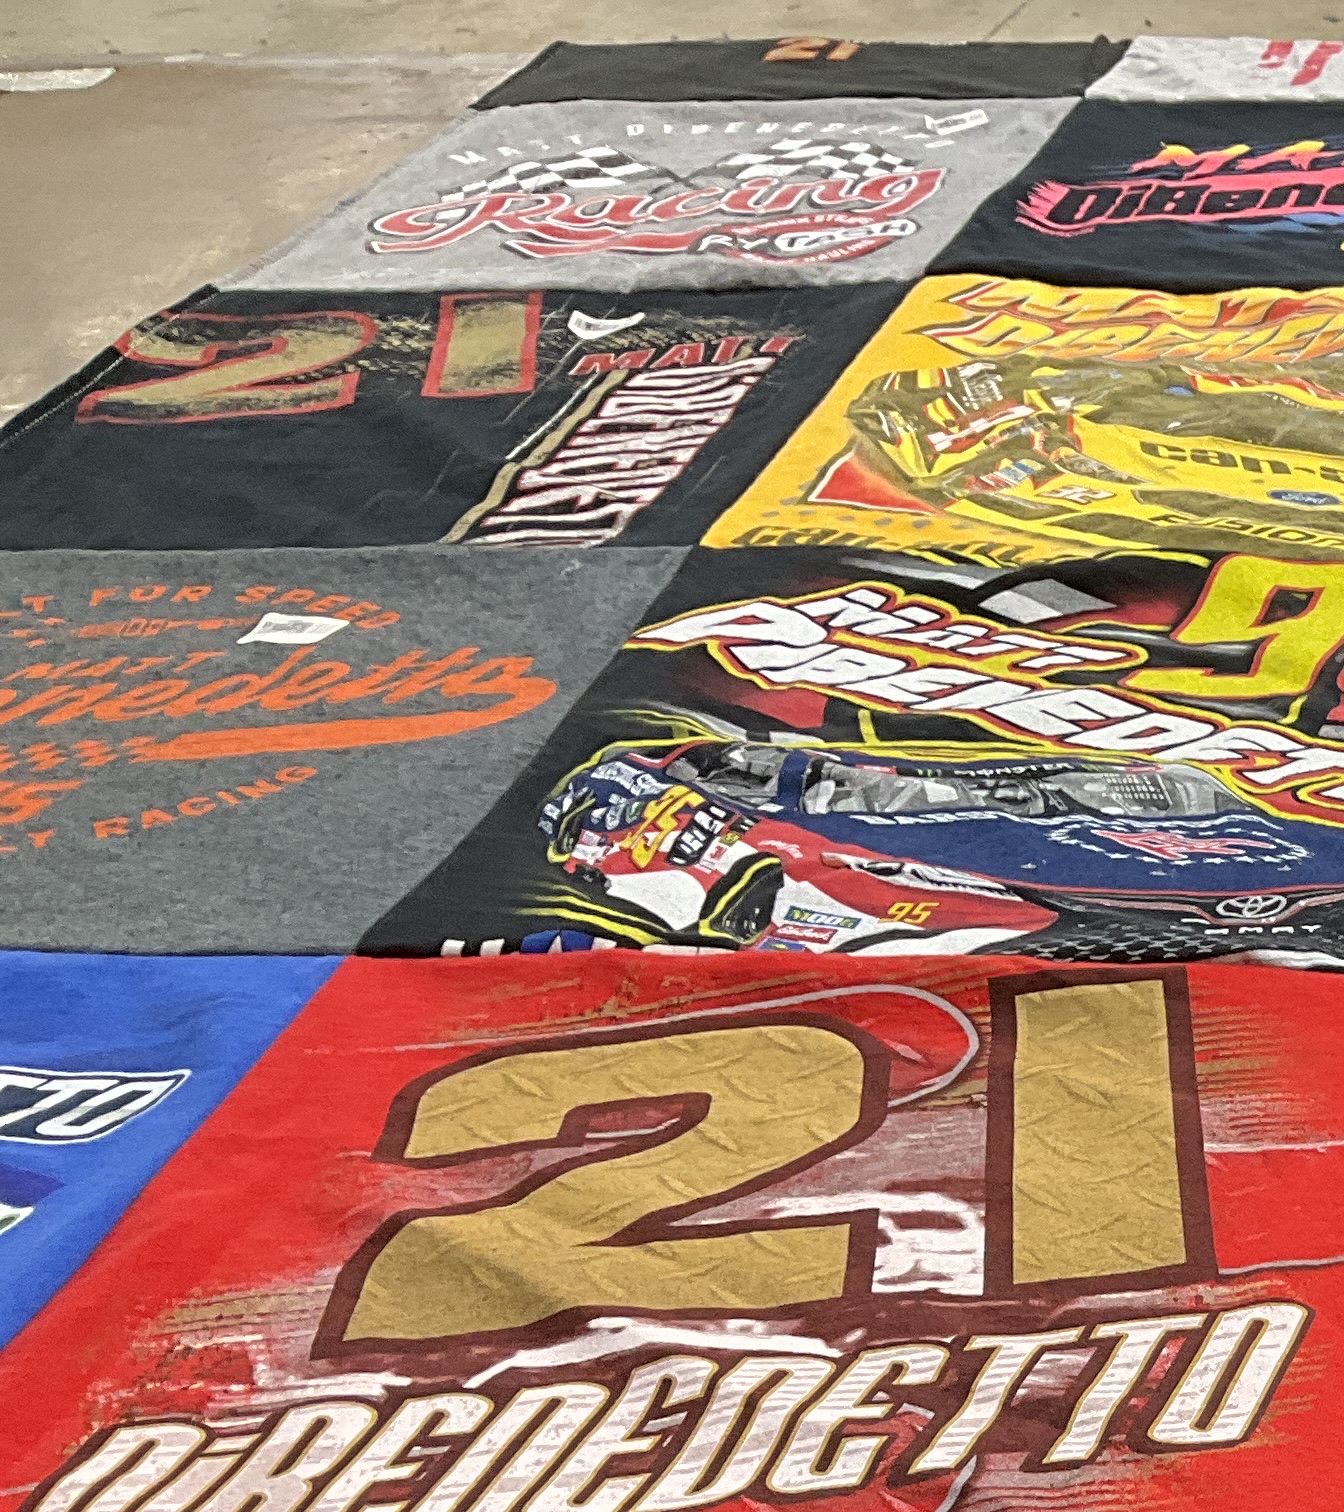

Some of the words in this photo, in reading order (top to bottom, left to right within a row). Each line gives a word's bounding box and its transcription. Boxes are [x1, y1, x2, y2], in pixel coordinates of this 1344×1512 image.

[370, 166, 948, 255] Racing
[75, 291, 544, 424] 21
[90, 584, 214, 607] FOR
[235, 584, 401, 631] SPEED
[93, 765, 319, 839] RACING
[878, 901, 941, 925] 95
[310, 968, 1220, 1360] 21
